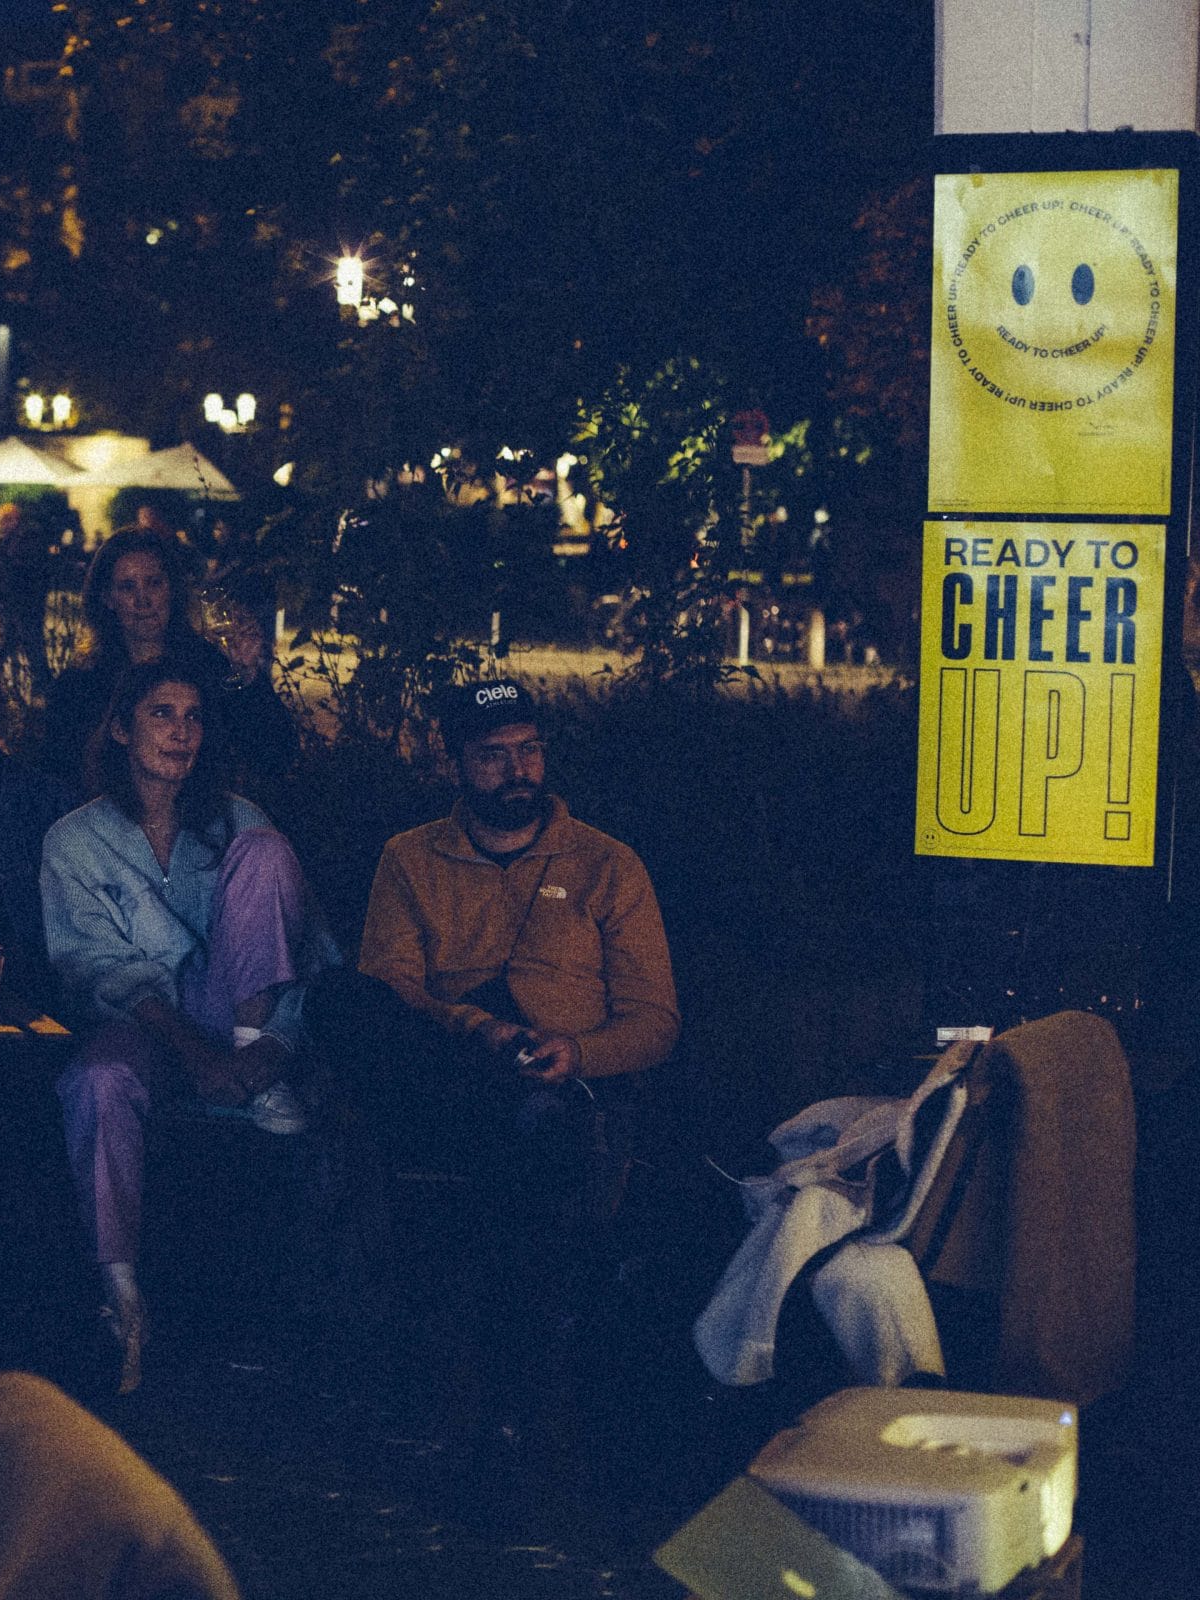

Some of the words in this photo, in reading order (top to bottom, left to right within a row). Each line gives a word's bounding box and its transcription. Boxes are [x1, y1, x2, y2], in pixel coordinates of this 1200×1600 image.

[997, 202, 1039, 226] CHEER
[1042, 199, 1064, 211] UP!
[1069, 200, 1113, 223] CHEER
[980, 223, 997, 239] TO
[955, 239, 981, 277] READY
[948, 279, 959, 302] UP!
[1149, 280, 1161, 298] TO
[947, 303, 963, 348] CHEER
[1145, 300, 1161, 346] CHEER
[996, 325, 1030, 357] READY
[1032, 346, 1049, 359] TO
[1051, 338, 1091, 359] CHEER
[1090, 324, 1107, 343] UP!
[958, 349, 972, 367] TO
[1133, 347, 1147, 369] UP!
[968, 366, 1005, 399] READY
[1096, 366, 1134, 399] READY
[1006, 393, 1027, 408] UP!
[1029, 400, 1073, 412] CHEER
[1076, 395, 1094, 408] TO
[944, 537, 1075, 568] READY
[1087, 540, 1139, 570] TO
[940, 572, 1138, 665] CHEER
[935, 667, 1136, 841] UP!
